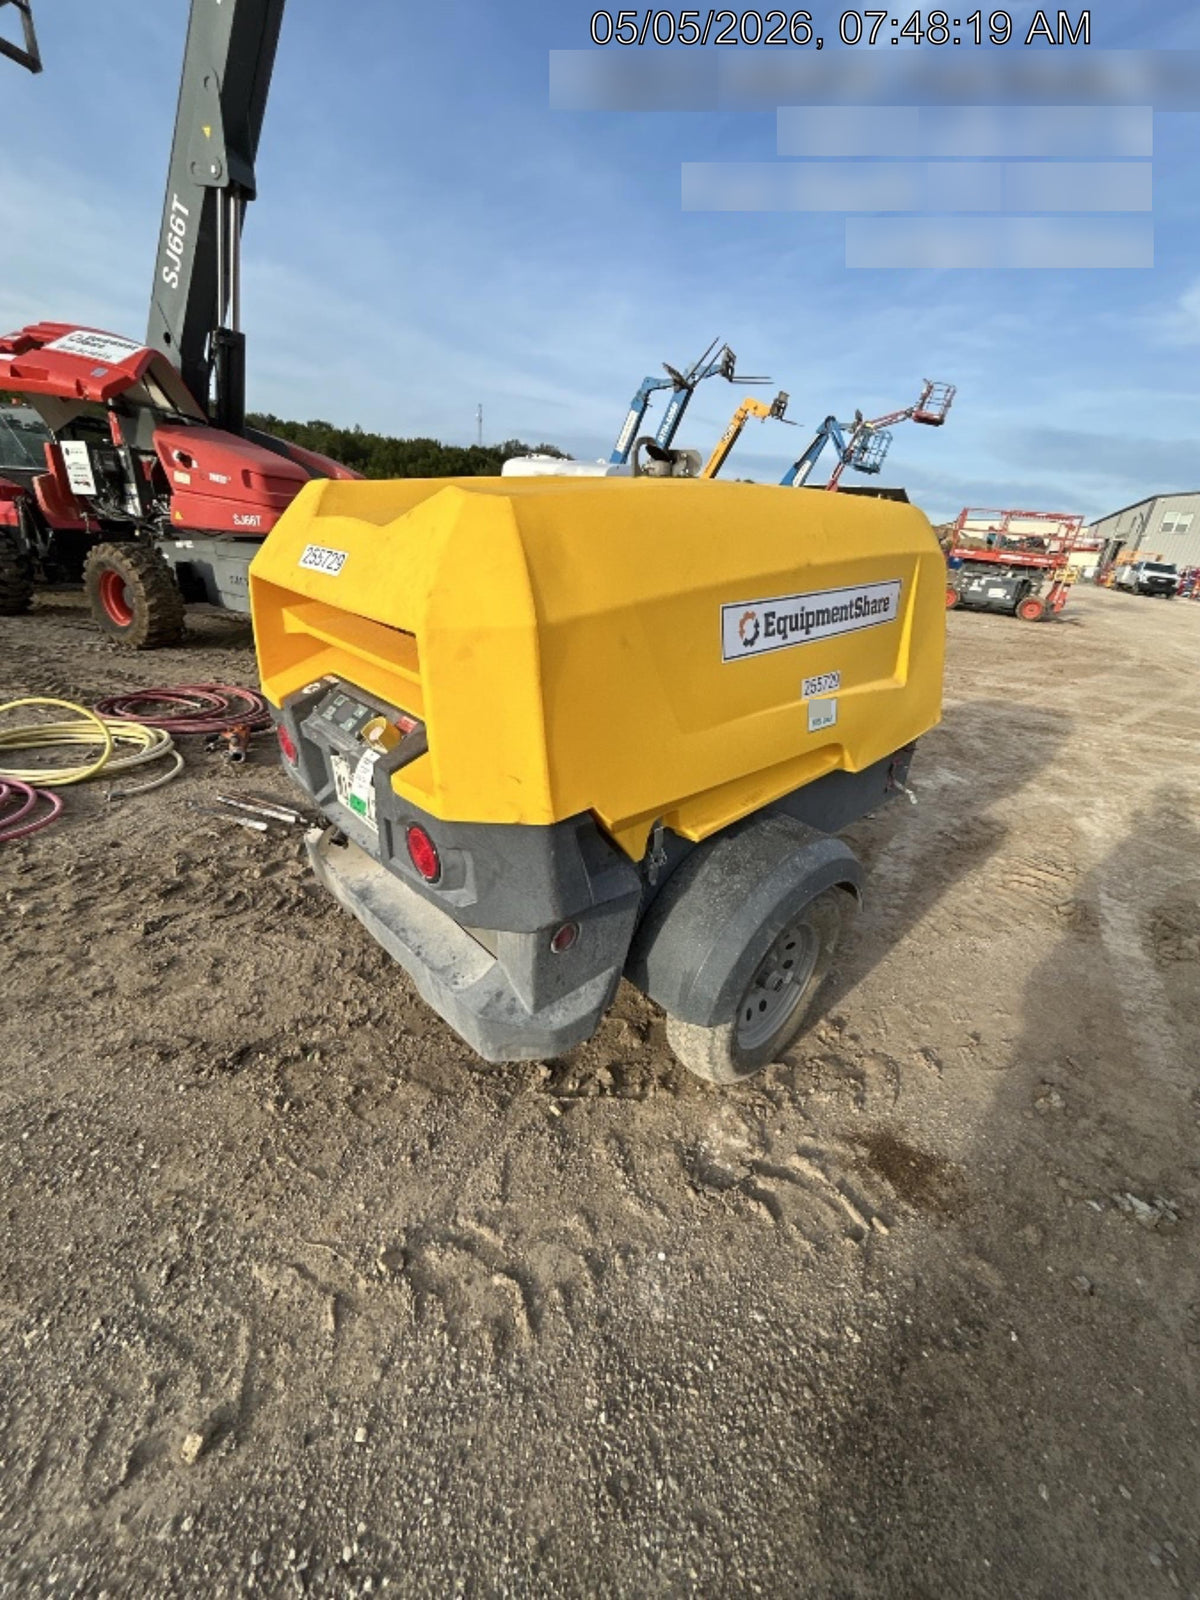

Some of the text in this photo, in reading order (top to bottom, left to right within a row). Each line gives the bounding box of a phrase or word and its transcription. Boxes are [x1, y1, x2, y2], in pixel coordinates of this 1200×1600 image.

[162, 192, 189, 289] SJ66T
[232, 513, 262, 526] SJ66T
[302, 546, 346, 572] 255729
[763, 595, 890, 640] EquipmentShare
[804, 672, 840, 696] 255729
